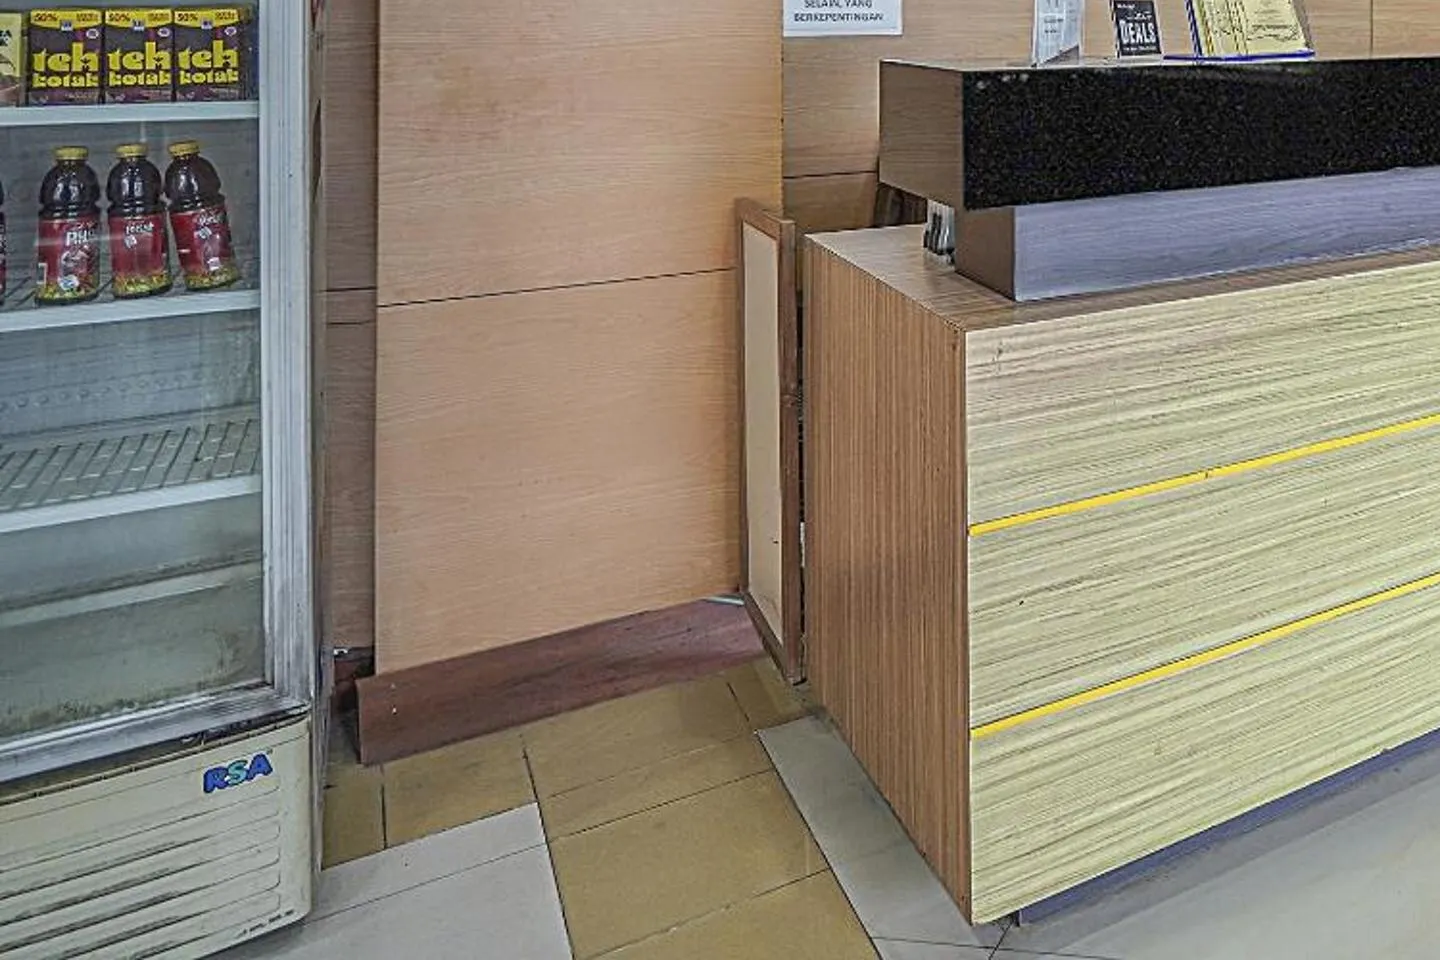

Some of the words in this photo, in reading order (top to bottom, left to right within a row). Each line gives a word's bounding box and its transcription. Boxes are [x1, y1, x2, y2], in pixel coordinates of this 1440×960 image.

[845, 0, 873, 8] YANG
[793, 13, 884, 22] BERKEPENTINGAN
[32, 41, 100, 72] teh
[107, 41, 171, 71] teh
[177, 39, 239, 69] teh
[32, 72, 99, 88] kotak
[107, 71, 171, 87] kotak
[179, 69, 239, 85] kotak
[203, 753, 273, 793] RSA
